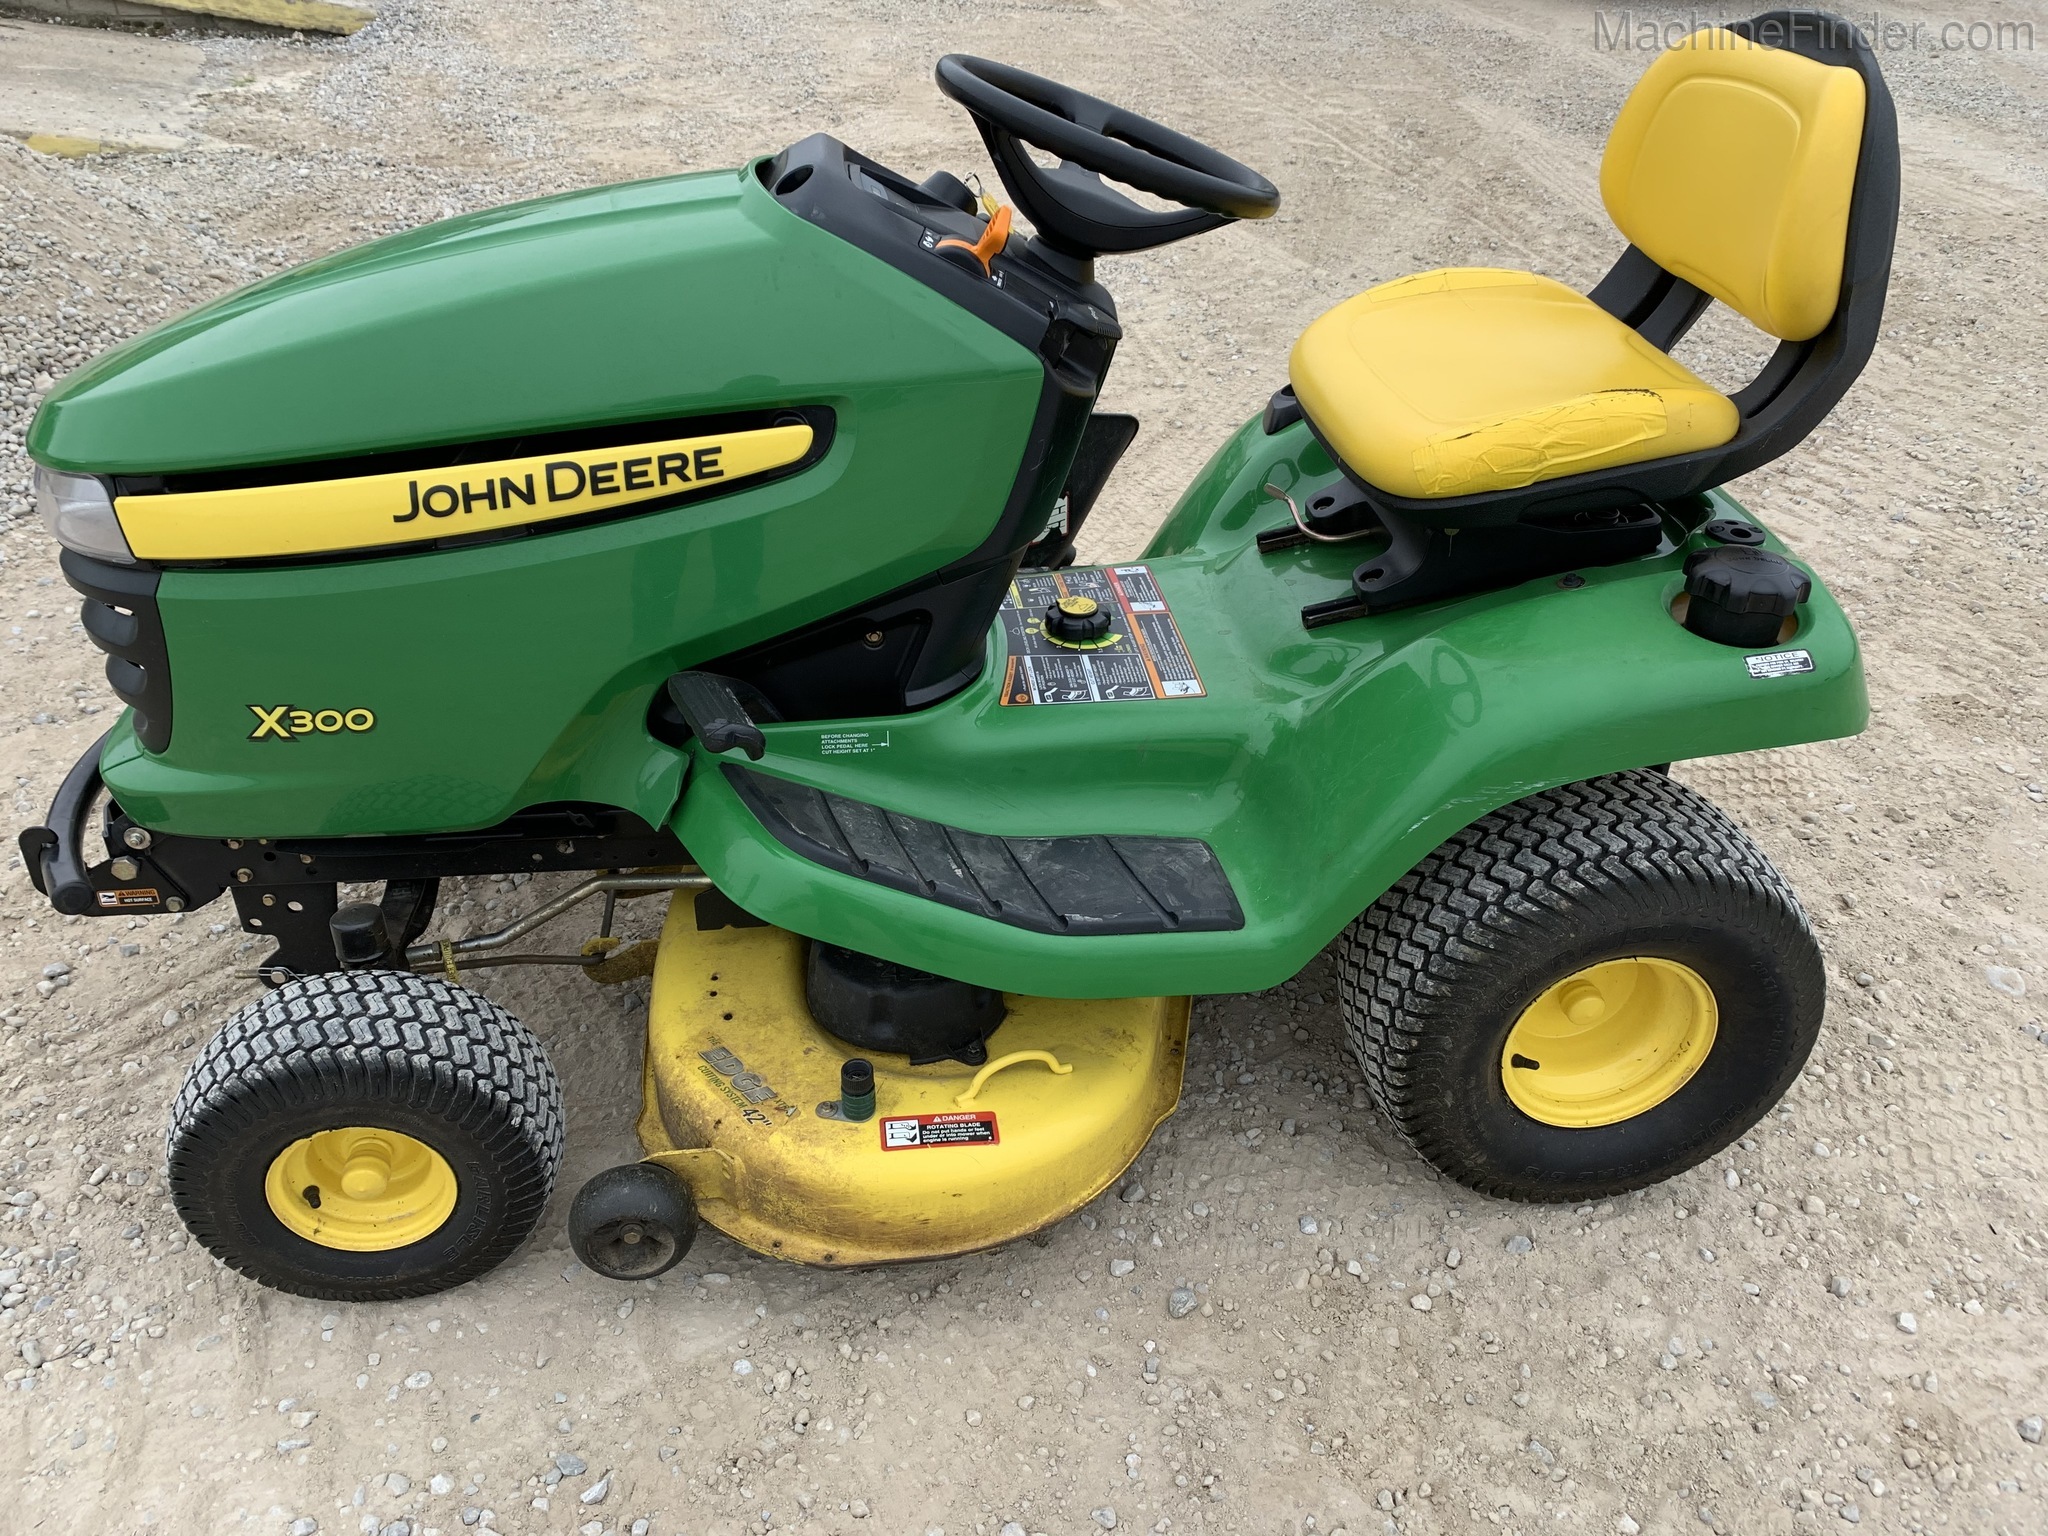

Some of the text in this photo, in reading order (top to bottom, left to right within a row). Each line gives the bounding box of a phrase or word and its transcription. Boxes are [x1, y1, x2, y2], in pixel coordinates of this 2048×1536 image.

[392, 446, 724, 523] JOHN DEERE
[1755, 652, 1800, 662] NOTICE
[248, 703, 376, 742] X300
[706, 1035, 722, 1046] THE
[697, 1046, 779, 1105] EDGE
[697, 1065, 774, 1127] CUTTING SYSTEM 42"
[942, 1114, 976, 1122] DANGER
[442, 1161, 493, 1263] CARLISLE
